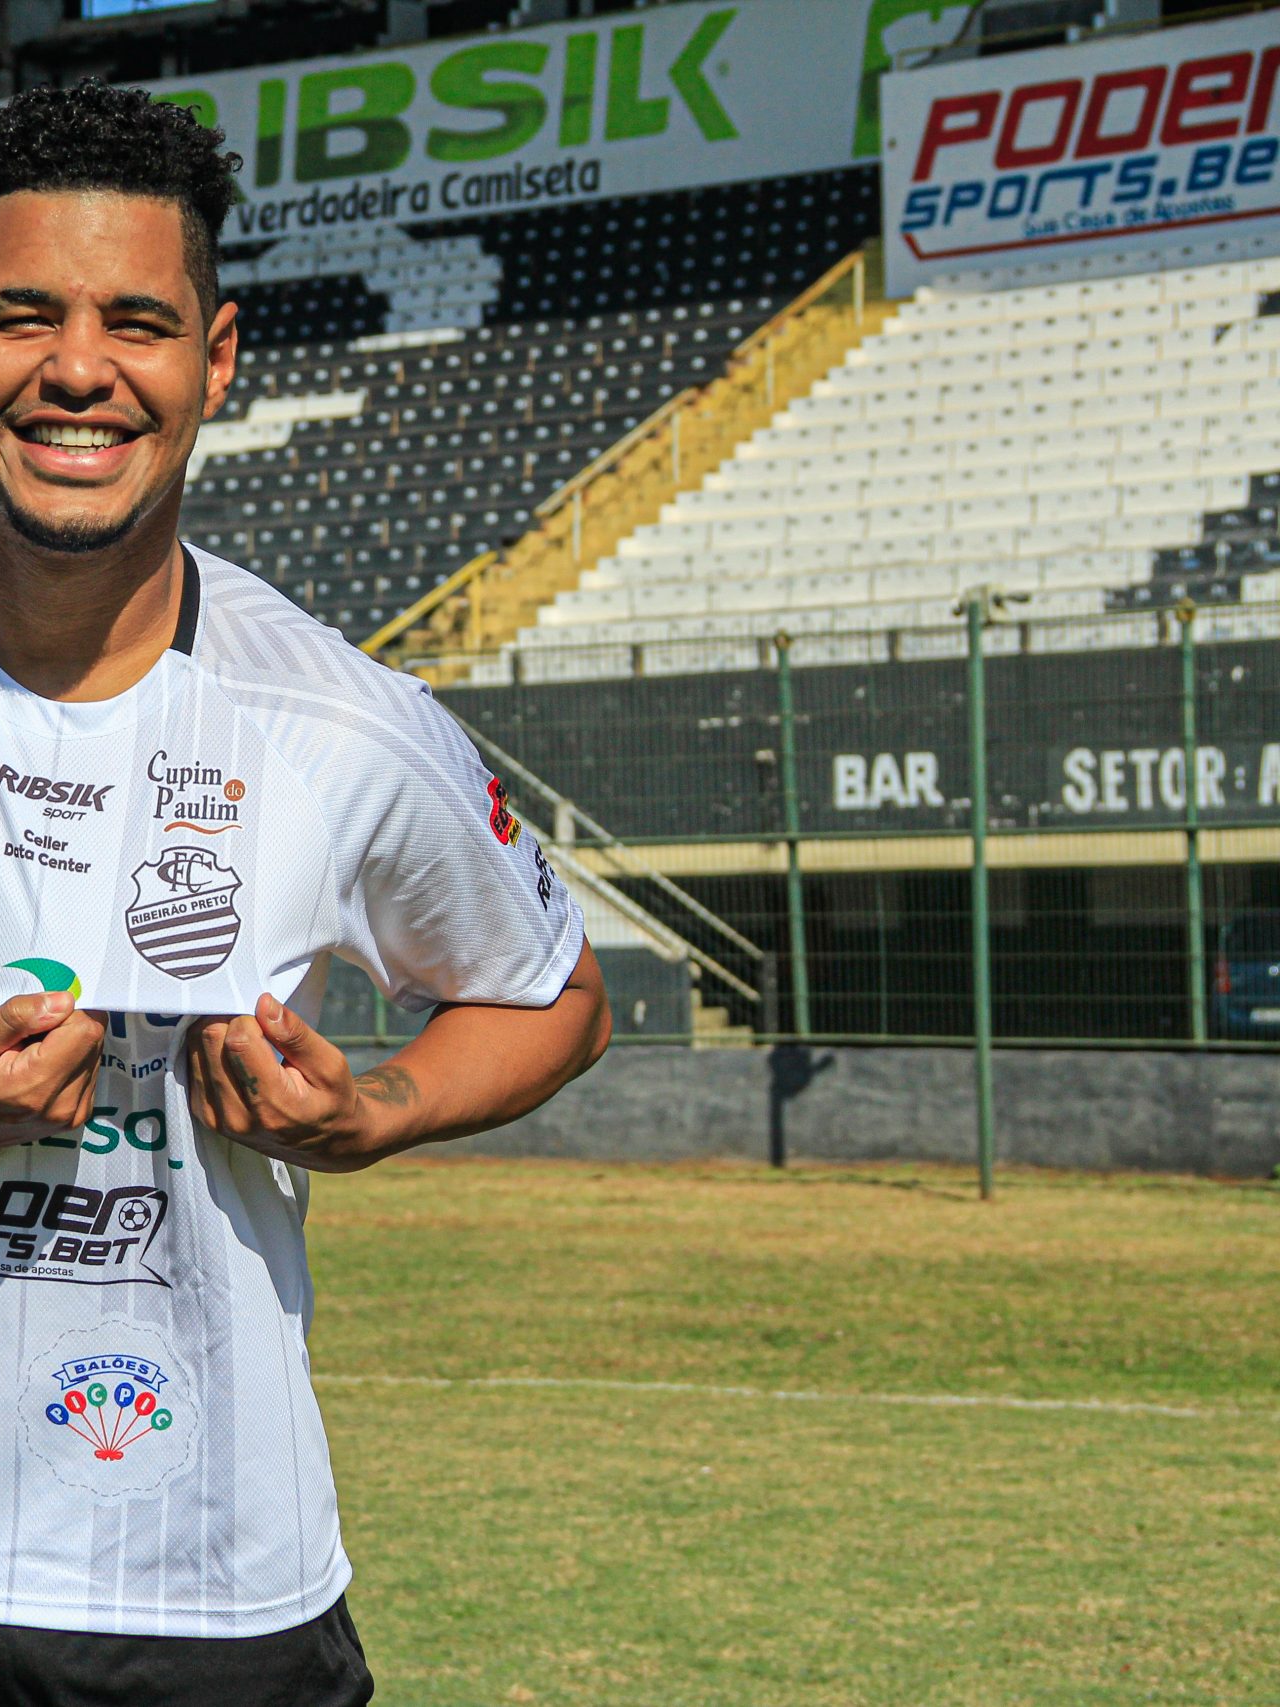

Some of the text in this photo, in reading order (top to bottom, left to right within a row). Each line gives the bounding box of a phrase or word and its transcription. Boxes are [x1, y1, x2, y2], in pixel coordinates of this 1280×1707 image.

[440, 156, 600, 209] Camiseta
[147, 750, 243, 797] Cupim do
[833, 752, 945, 810] BAR
[153, 785, 238, 821] Paulim
[24, 829, 68, 852] Celler
[4, 842, 91, 873] Data Center
[131, 895, 228, 925] RIBEIRÃO PRETO
[14, 1264, 29, 1273] de
[31, 1266, 74, 1277] apostas
[74, 1358, 150, 1375] BALÕES
